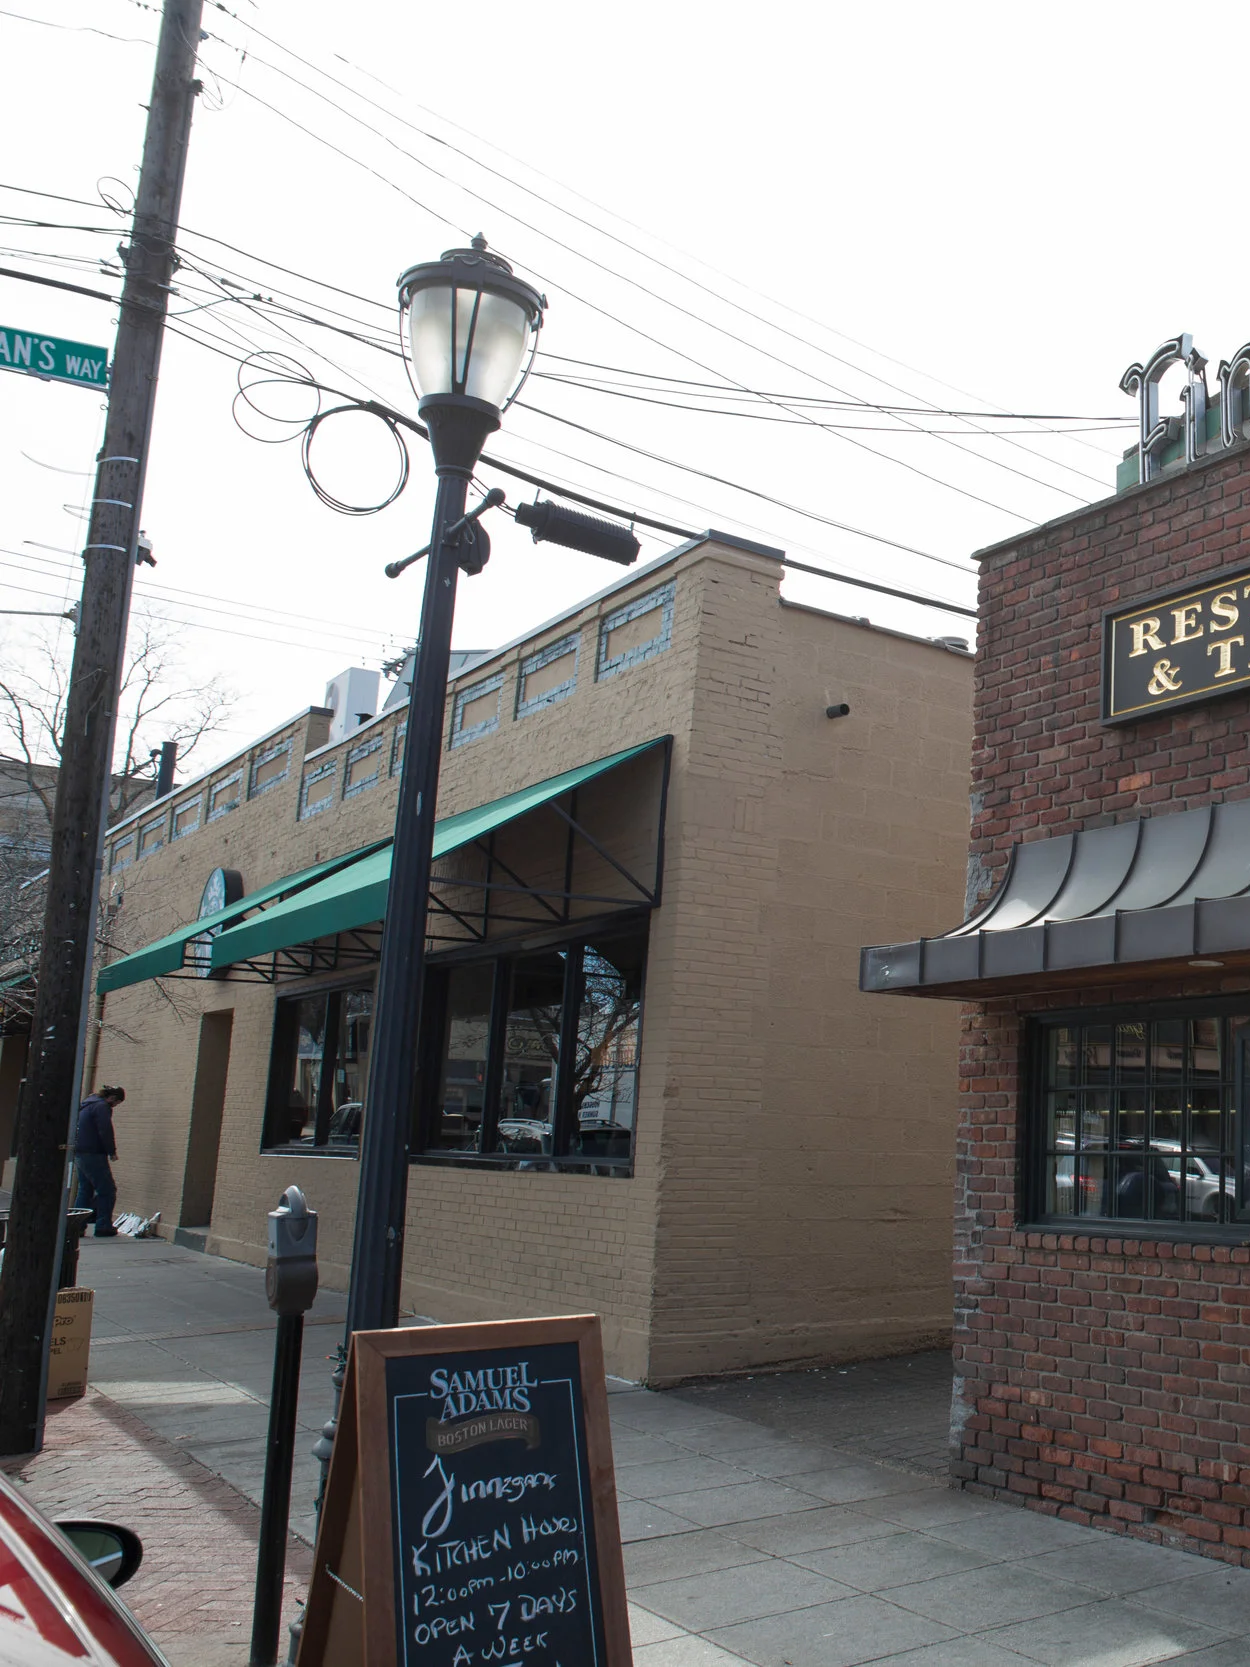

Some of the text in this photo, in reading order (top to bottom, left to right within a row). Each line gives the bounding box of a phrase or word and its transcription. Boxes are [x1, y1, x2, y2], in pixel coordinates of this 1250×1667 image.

[65, 354, 103, 380] WAY
[1147, 657, 1183, 695] &
[429, 1361, 539, 1399] SAMUEL
[438, 1386, 532, 1425] ADAMS
[437, 1417, 529, 1448] BOSTON LAGER
[411, 1522, 513, 1577] KITCHEN
[414, 1586, 578, 1645] OPEN 7 DAYS
[452, 1631, 549, 1667] A WEEK
